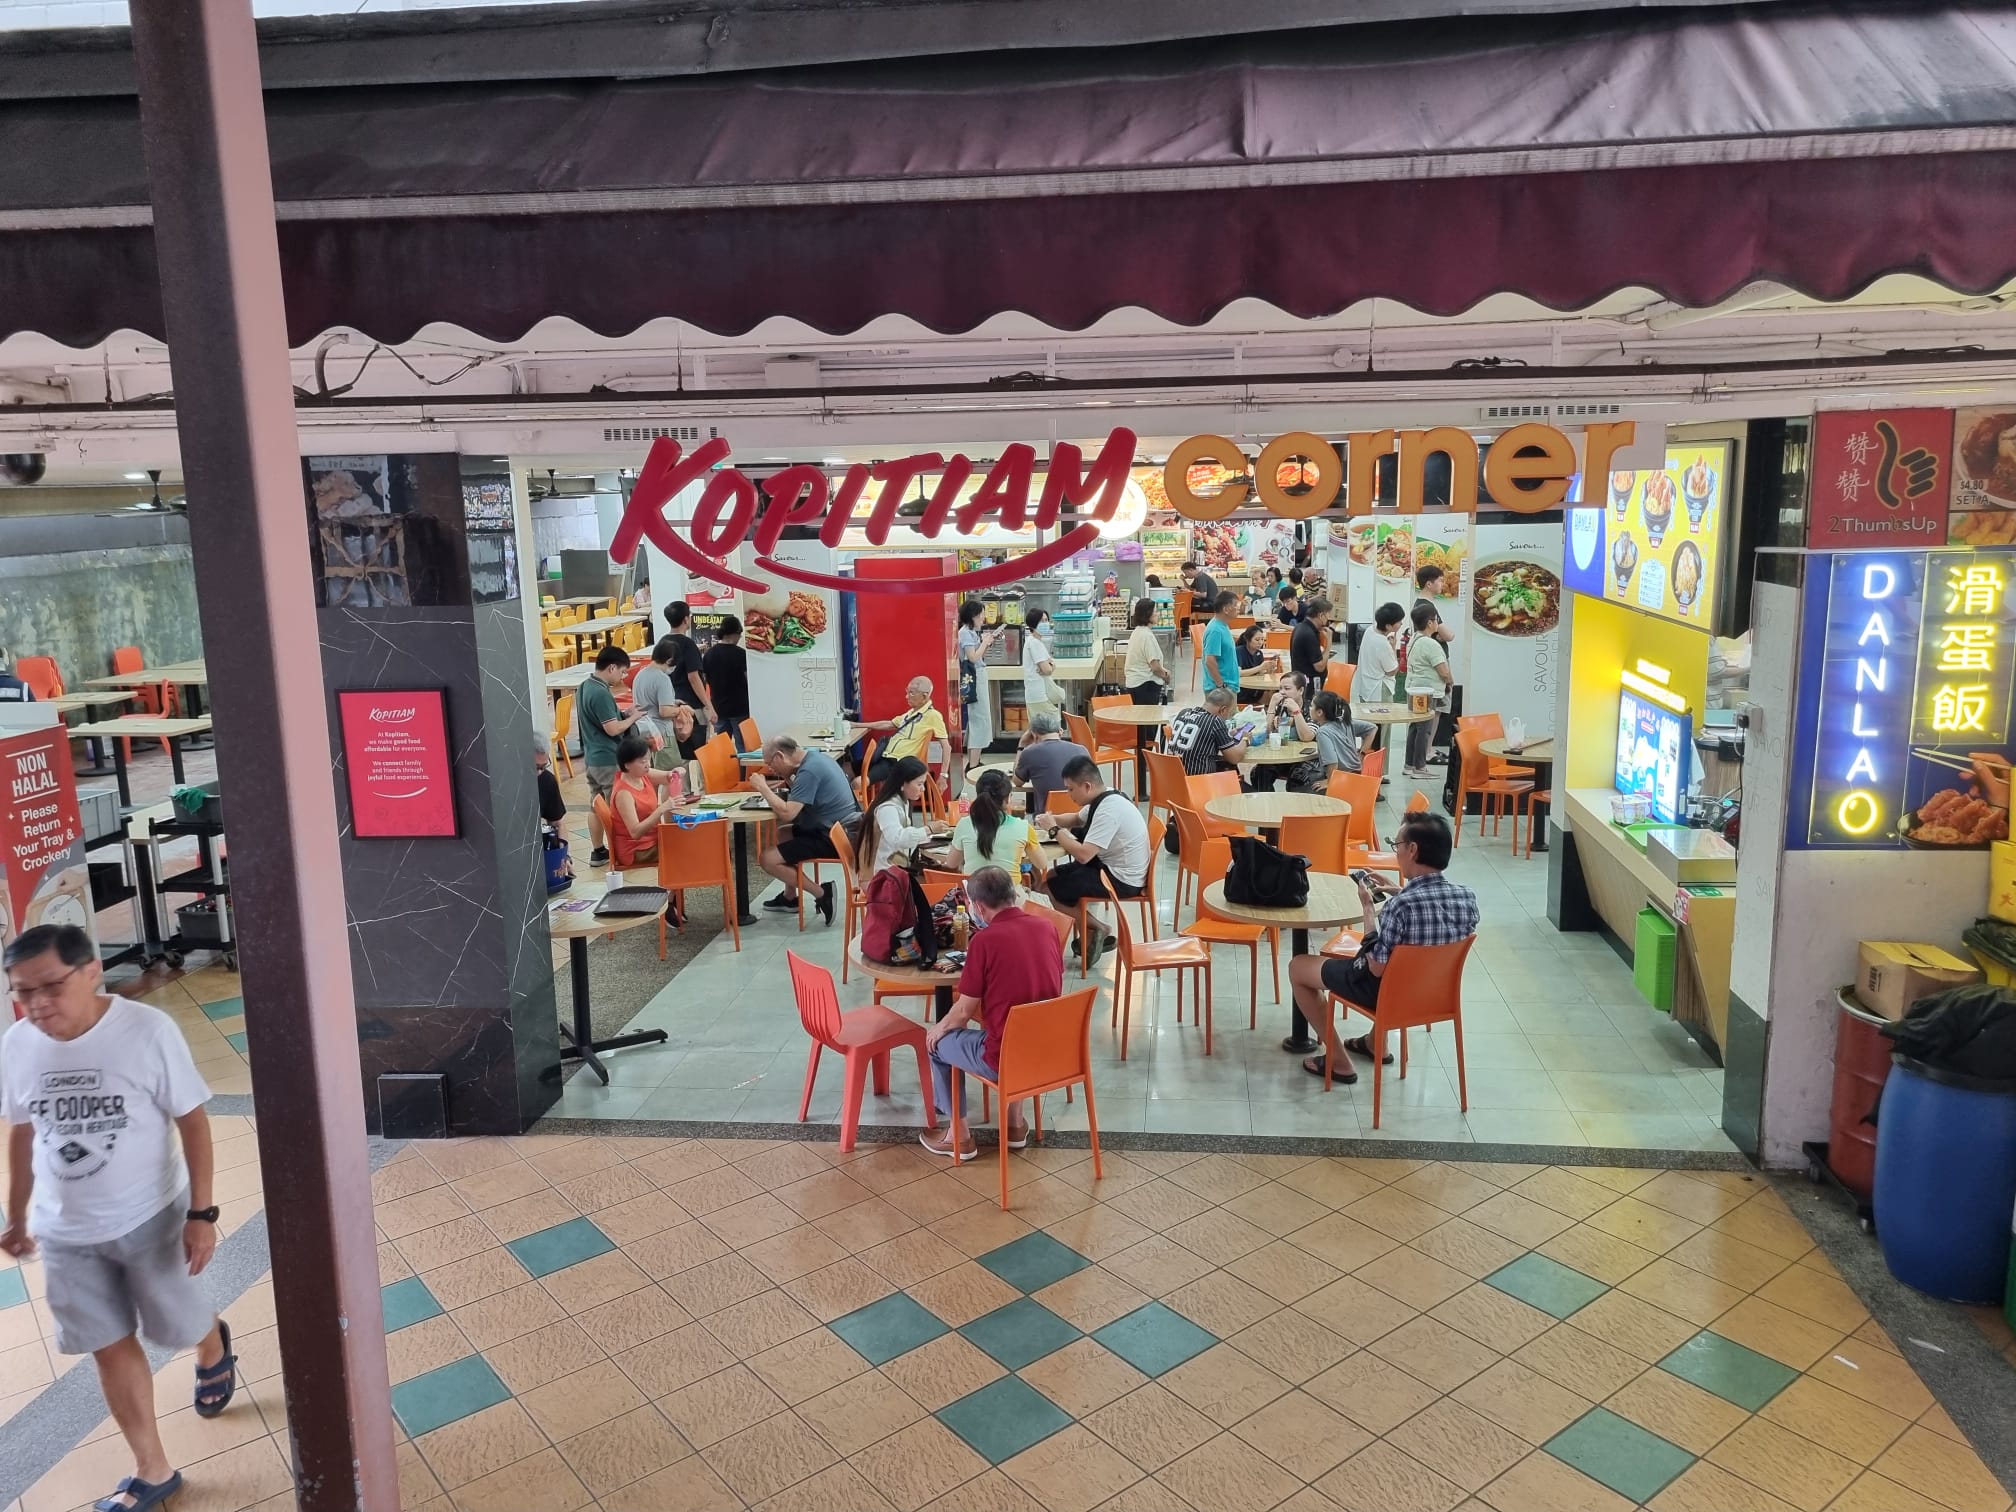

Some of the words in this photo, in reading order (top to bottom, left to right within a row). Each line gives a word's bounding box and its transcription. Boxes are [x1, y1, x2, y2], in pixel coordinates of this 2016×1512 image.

[1164, 421, 1635, 520] corner
[1959, 479, 1984, 492] $4.80
[1931, 563, 2002, 733] 滑蛋飯
[1837, 563, 1896, 835] DANLAO
[369, 707, 416, 721] KOPITIAM
[17, 752, 47, 775] NON
[404, 759, 421, 767] family
[12, 770, 58, 797] HALAL
[21, 803, 58, 823] Please
[23, 818, 61, 838] Return
[13, 841, 40, 858] Your
[40, 834, 68, 847] Tray
[66, 828, 75, 840] &
[22, 847, 72, 872] Crockery
[44, 1075, 97, 1088] LONDON
[55, 1095, 126, 1121] COOPER
[86, 1115, 129, 1134] HERITAGE
